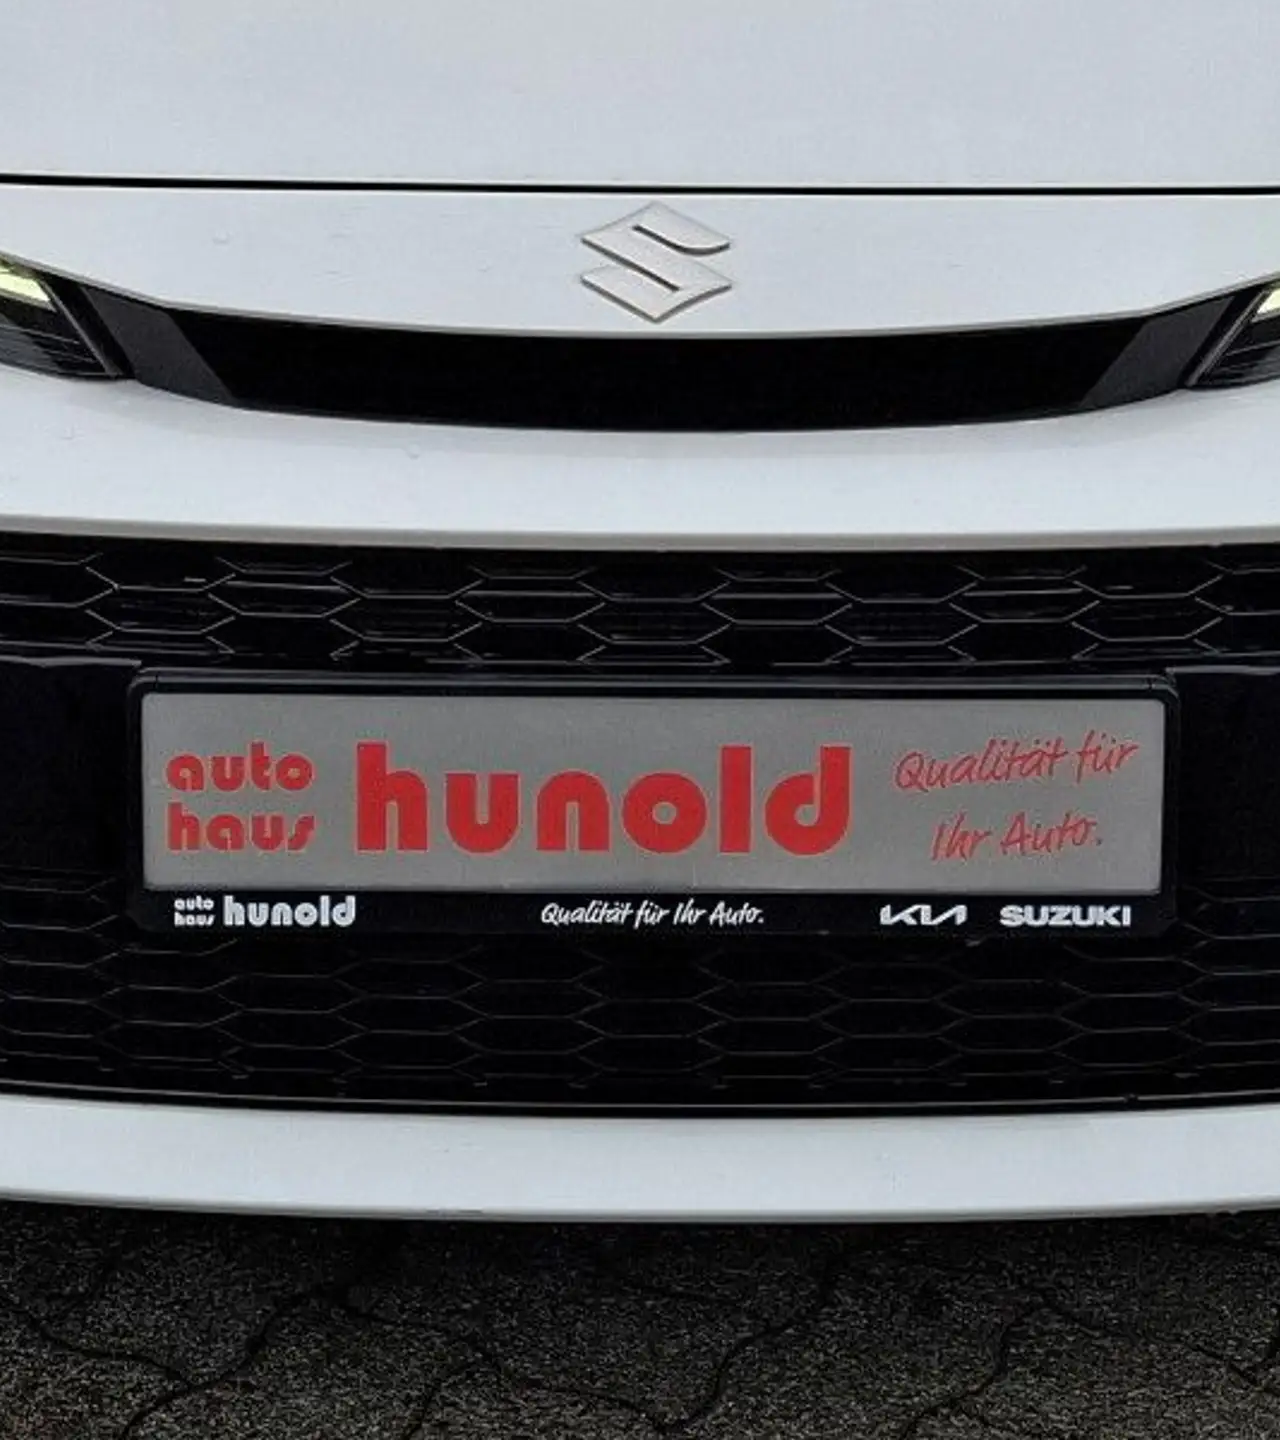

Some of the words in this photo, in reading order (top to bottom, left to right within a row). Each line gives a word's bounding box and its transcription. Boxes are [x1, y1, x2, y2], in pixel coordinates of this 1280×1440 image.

[166, 740, 314, 792] auto
[893, 735, 1069, 793] Qualität
[1075, 729, 1140, 784] für
[355, 740, 854, 856] hunold
[166, 800, 316, 852] haus
[931, 810, 993, 861] Ihr
[998, 811, 1104, 856] Auto.
[173, 895, 215, 910] auto
[173, 912, 215, 927] haus
[223, 895, 357, 927] hunold
[540, 900, 634, 925] Qualität
[633, 899, 670, 929] für
[672, 898, 707, 926] Ihr
[708, 900, 765, 925] Auto.
[999, 904, 1131, 927] SUZUKI
